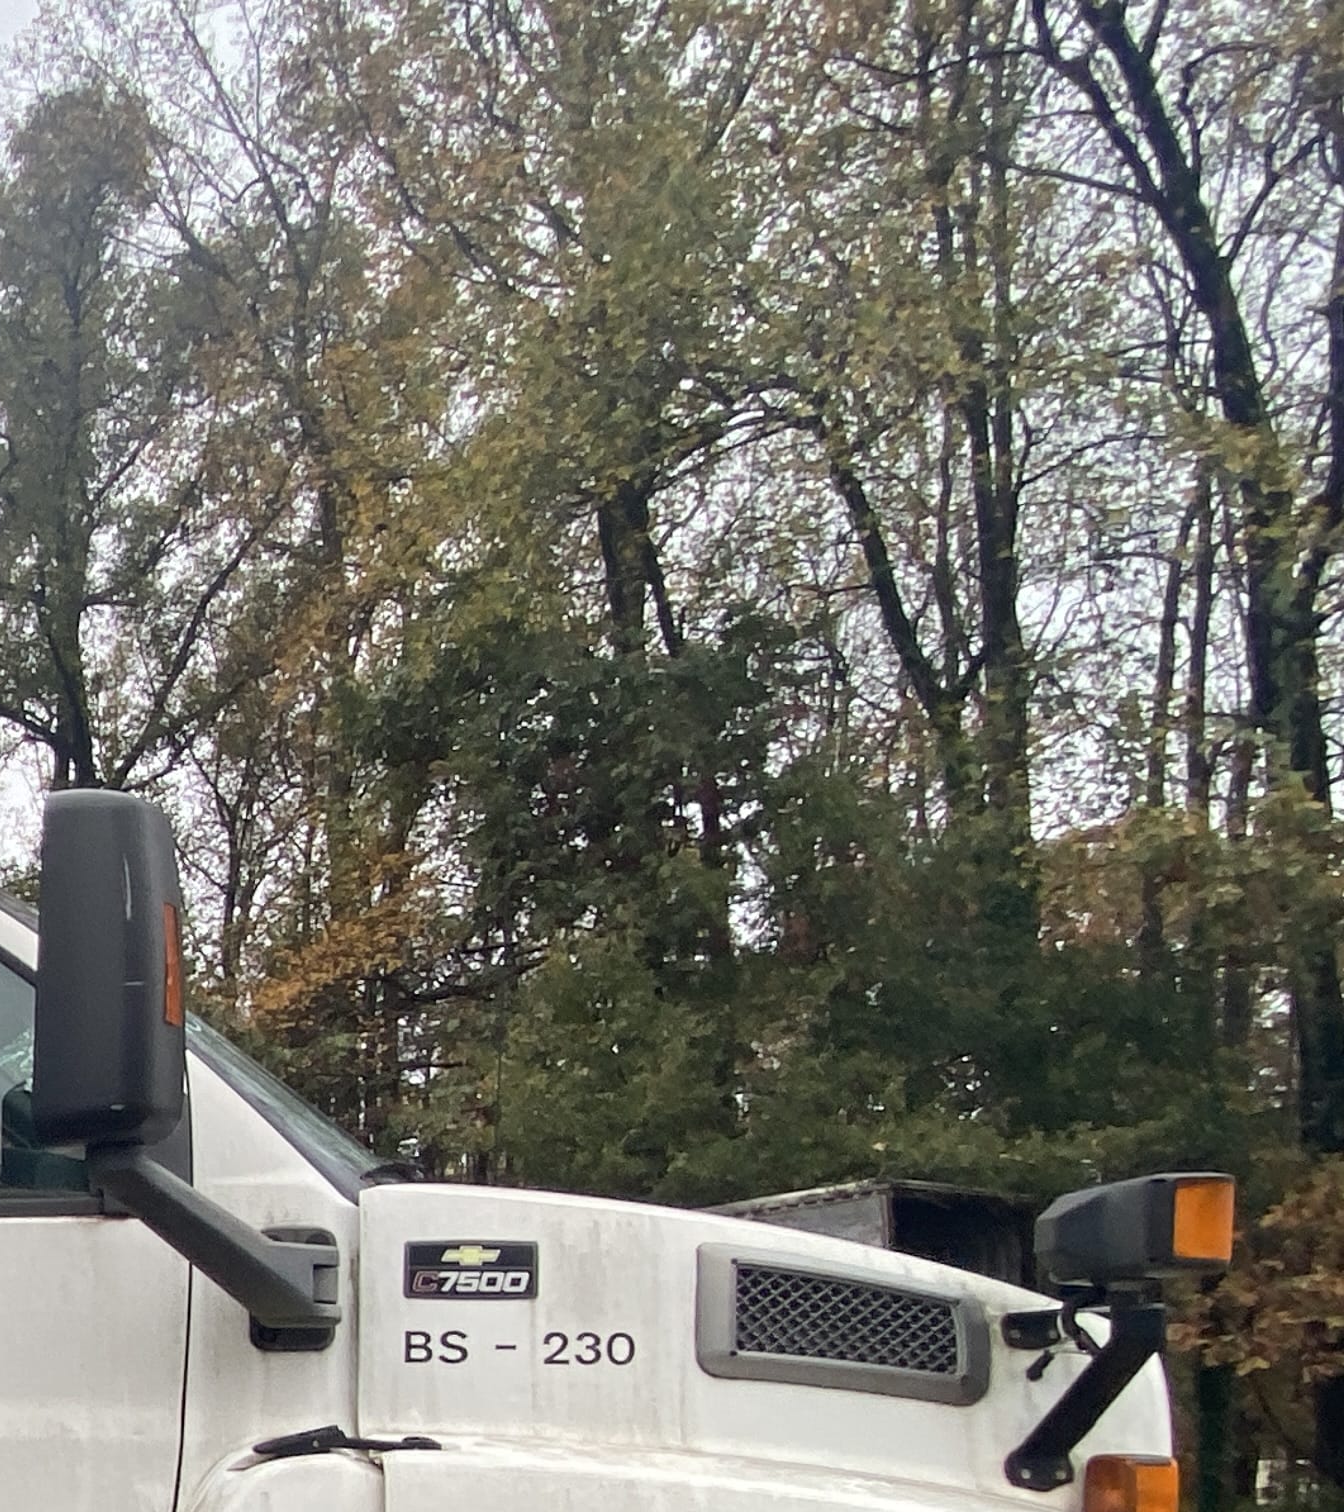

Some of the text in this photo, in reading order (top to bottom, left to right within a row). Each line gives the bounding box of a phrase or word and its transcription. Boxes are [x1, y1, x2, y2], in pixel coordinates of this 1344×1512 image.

[413, 1270, 530, 1293] C7500
[404, 1330, 469, 1364] BS
[543, 1332, 636, 1366] 230
